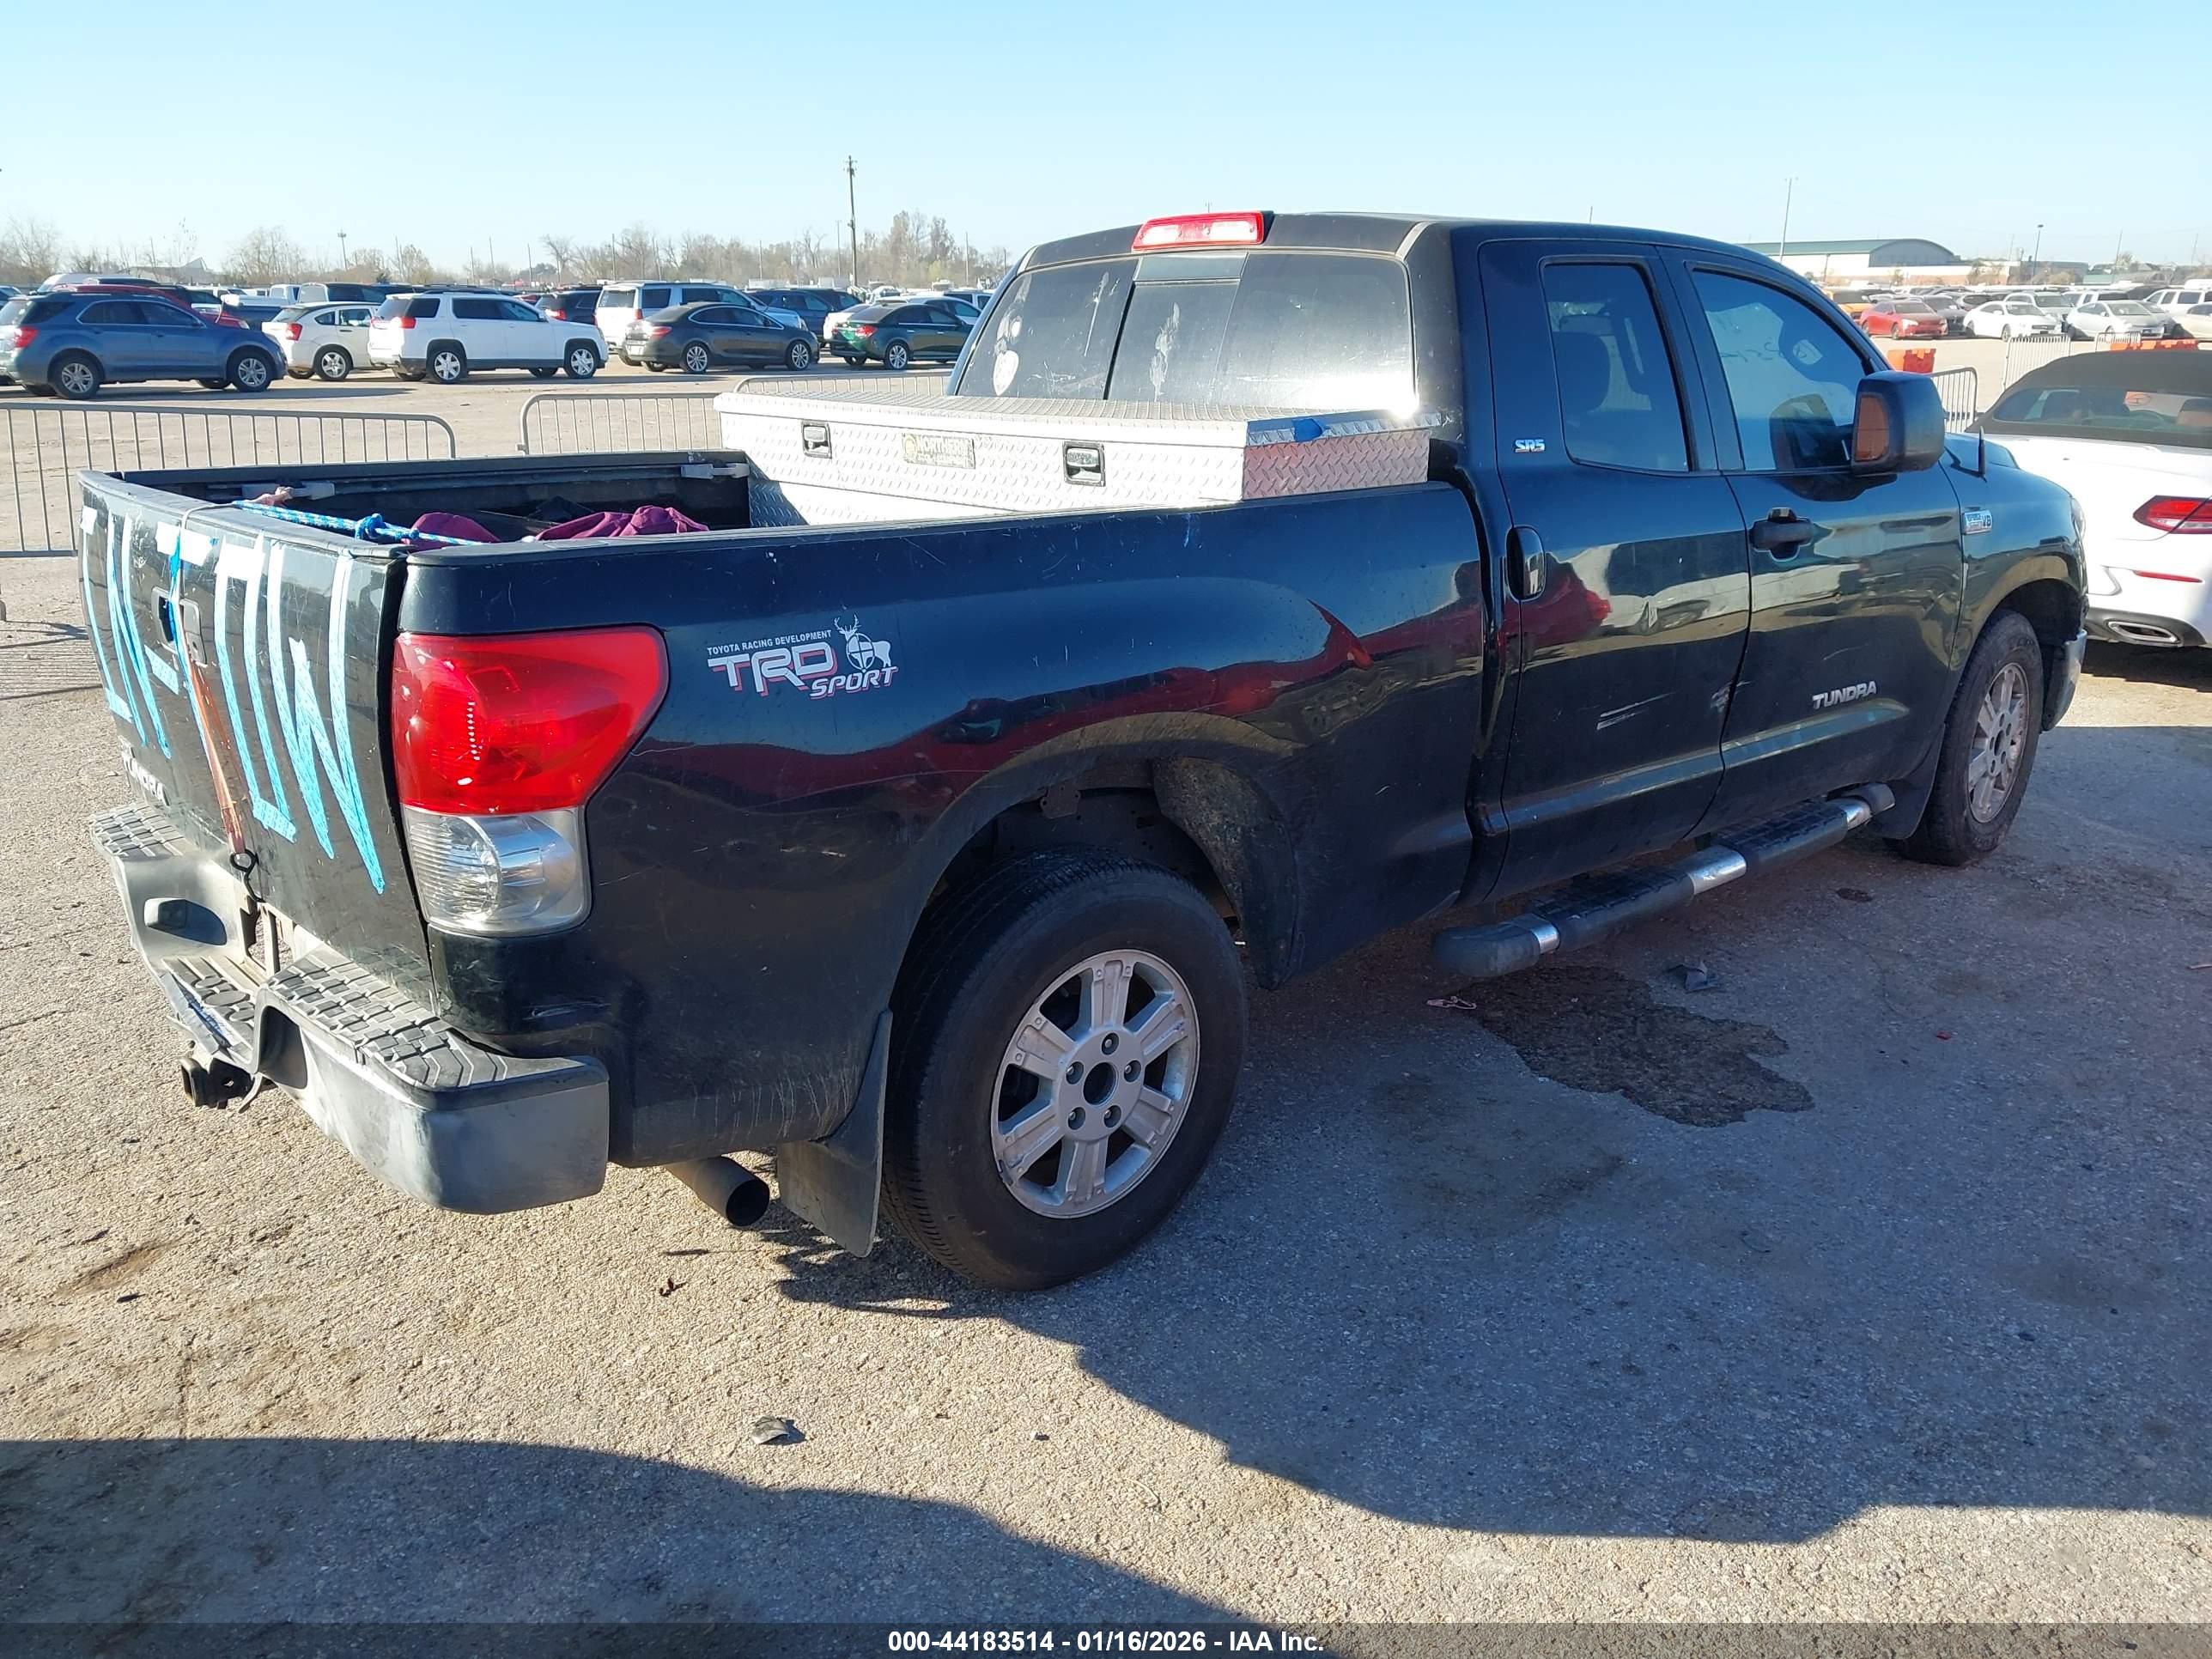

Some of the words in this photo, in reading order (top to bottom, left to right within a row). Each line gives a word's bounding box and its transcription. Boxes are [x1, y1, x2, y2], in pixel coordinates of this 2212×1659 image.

[1515, 439, 1545, 453] SR5
[708, 643, 740, 655] TOYOTA
[742, 638, 773, 651] RACING
[775, 629, 832, 646] DEVELOPMENT
[708, 641, 837, 696] TRD
[810, 666, 898, 699] SPORT
[1812, 681, 1877, 709] TUNDRA
[121, 748, 171, 807] TUNDRA
